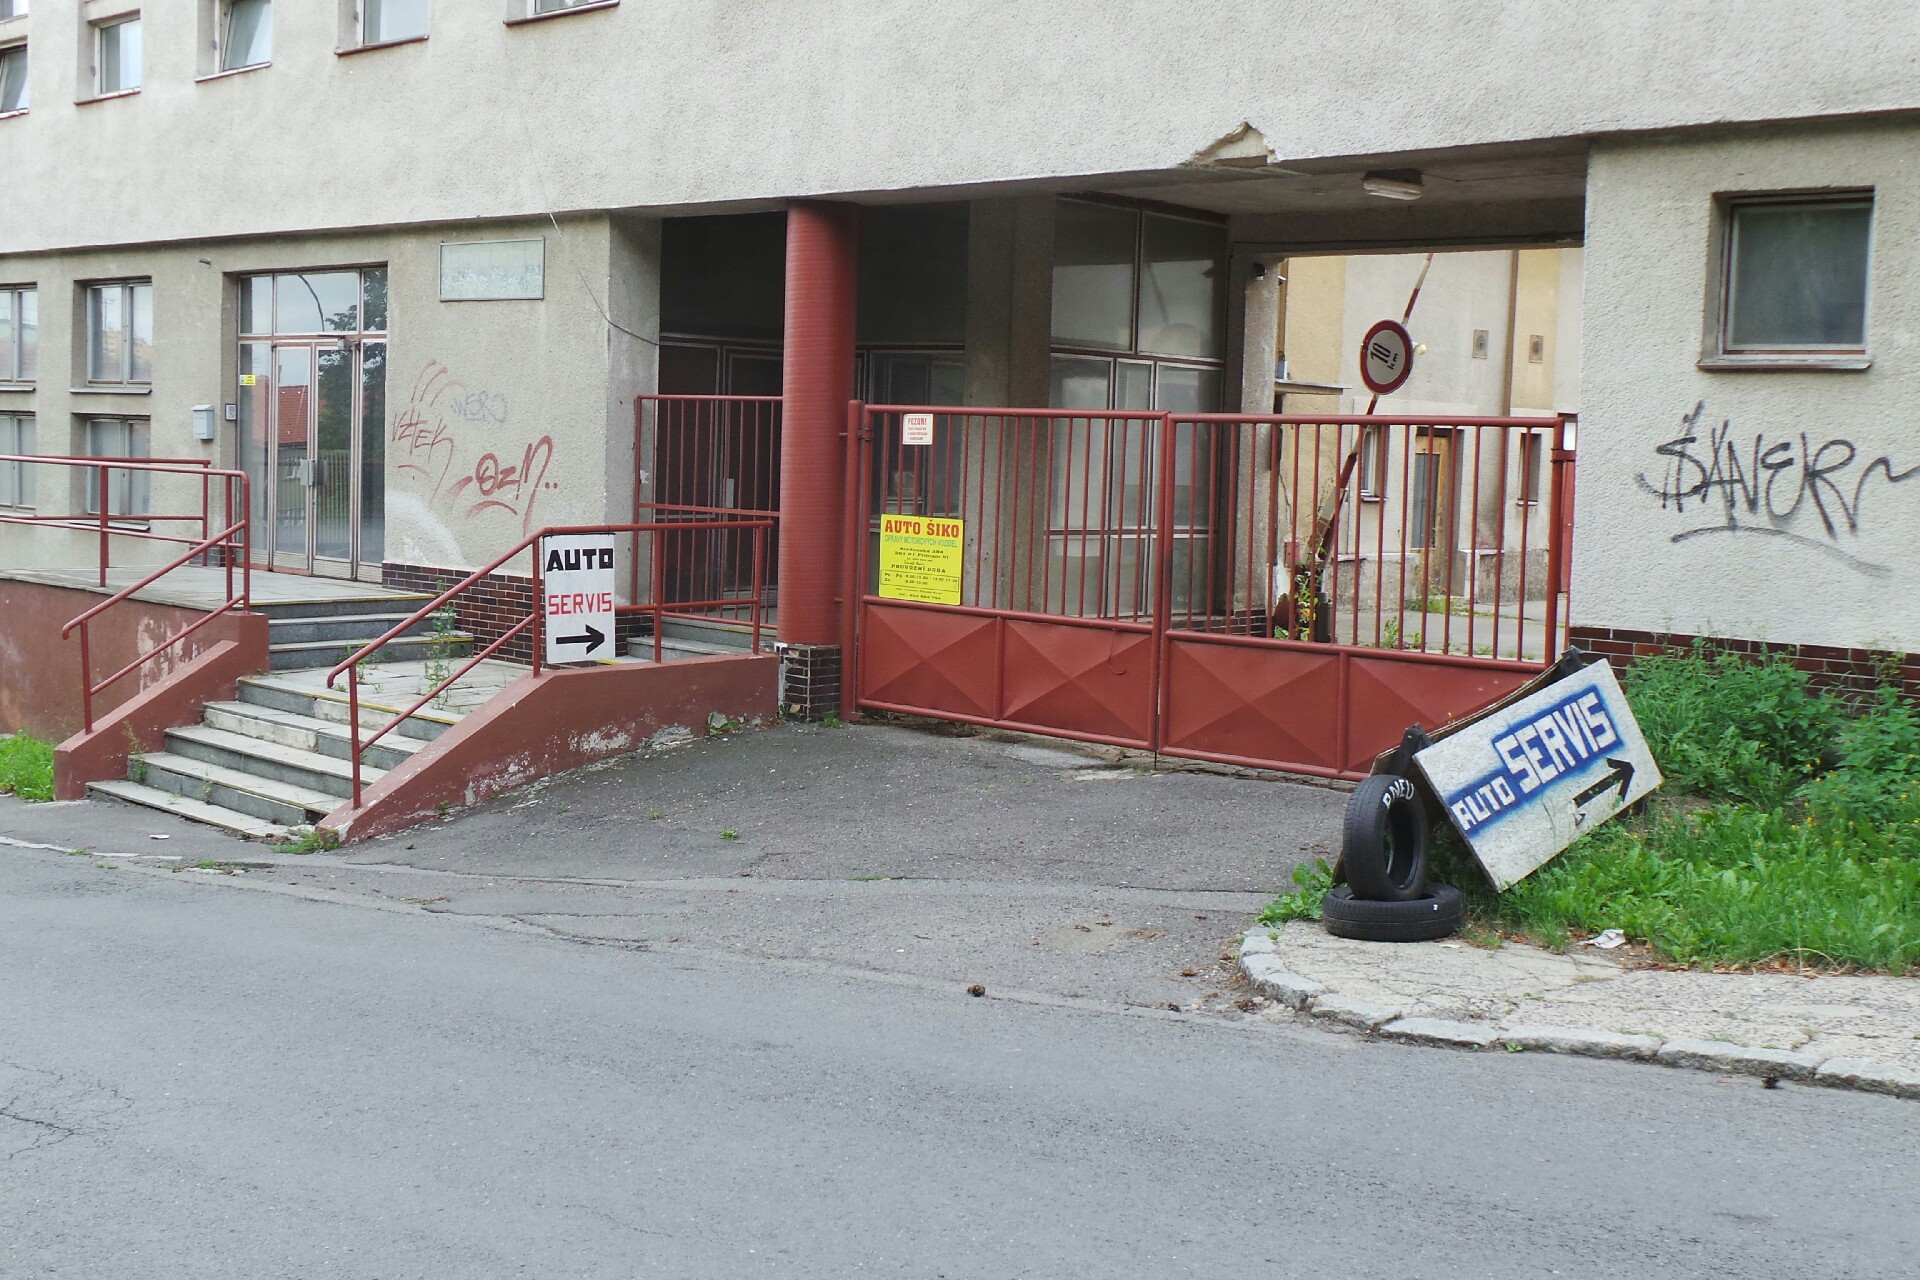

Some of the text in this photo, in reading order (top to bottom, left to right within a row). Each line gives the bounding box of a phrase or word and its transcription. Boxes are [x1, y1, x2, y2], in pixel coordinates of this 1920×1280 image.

[1370, 342, 1391, 364] 10
[907, 417, 927, 426] POZOR!
[884, 518, 960, 538] AUTO ŠIKO
[546, 548, 614, 572] AUTO
[548, 592, 613, 615] SERVIS
[1493, 691, 1617, 795] SERVIS
[1382, 778, 1415, 810] PNEU
[1450, 777, 1516, 831] AUTO
